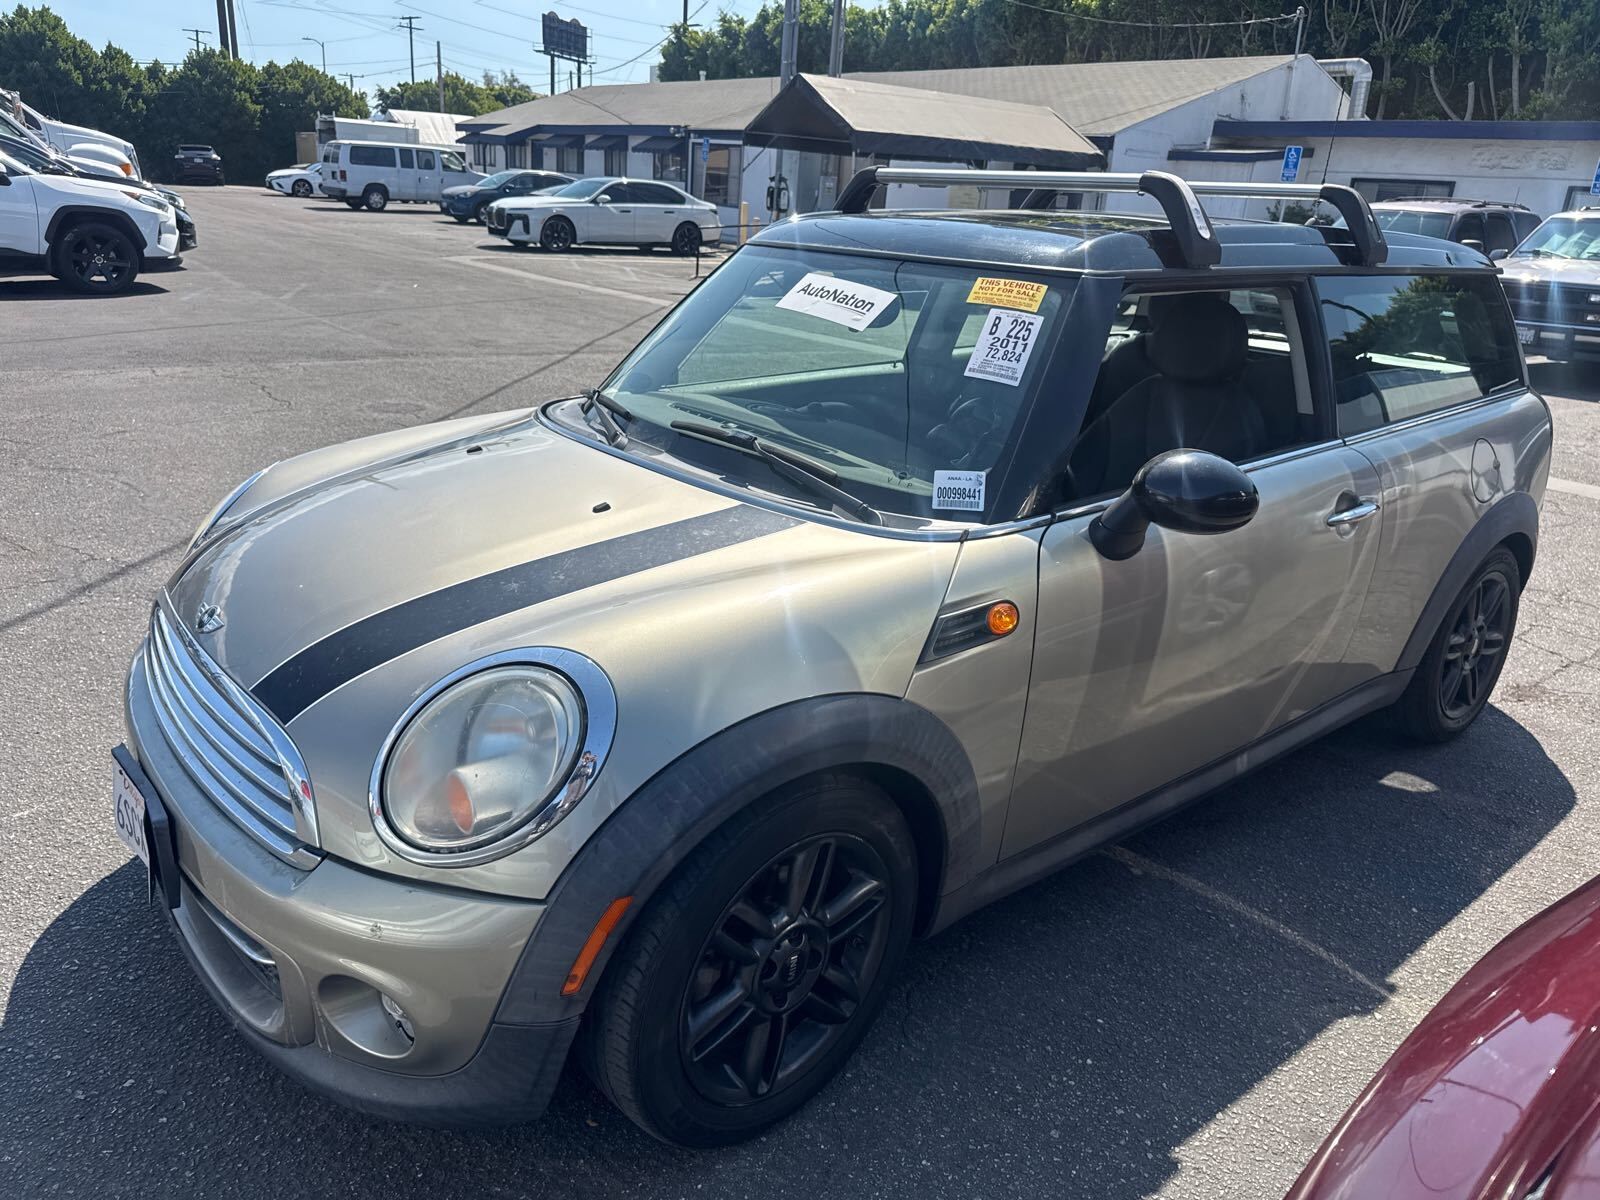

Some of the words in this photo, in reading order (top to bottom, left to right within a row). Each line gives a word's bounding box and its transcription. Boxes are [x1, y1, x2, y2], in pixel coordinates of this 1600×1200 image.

[980, 278, 1001, 287] THIS
[1003, 281, 1043, 293] VEHICLE
[996, 287, 1014, 295] FOR
[1015, 290, 1038, 298] SALE
[797, 282, 875, 312] AutoNation
[988, 316, 1002, 336] B
[1005, 318, 1034, 342] 225
[990, 336, 1029, 353] 2011
[985, 347, 1022, 364] 72,824
[937, 486, 981, 500] 000998441
